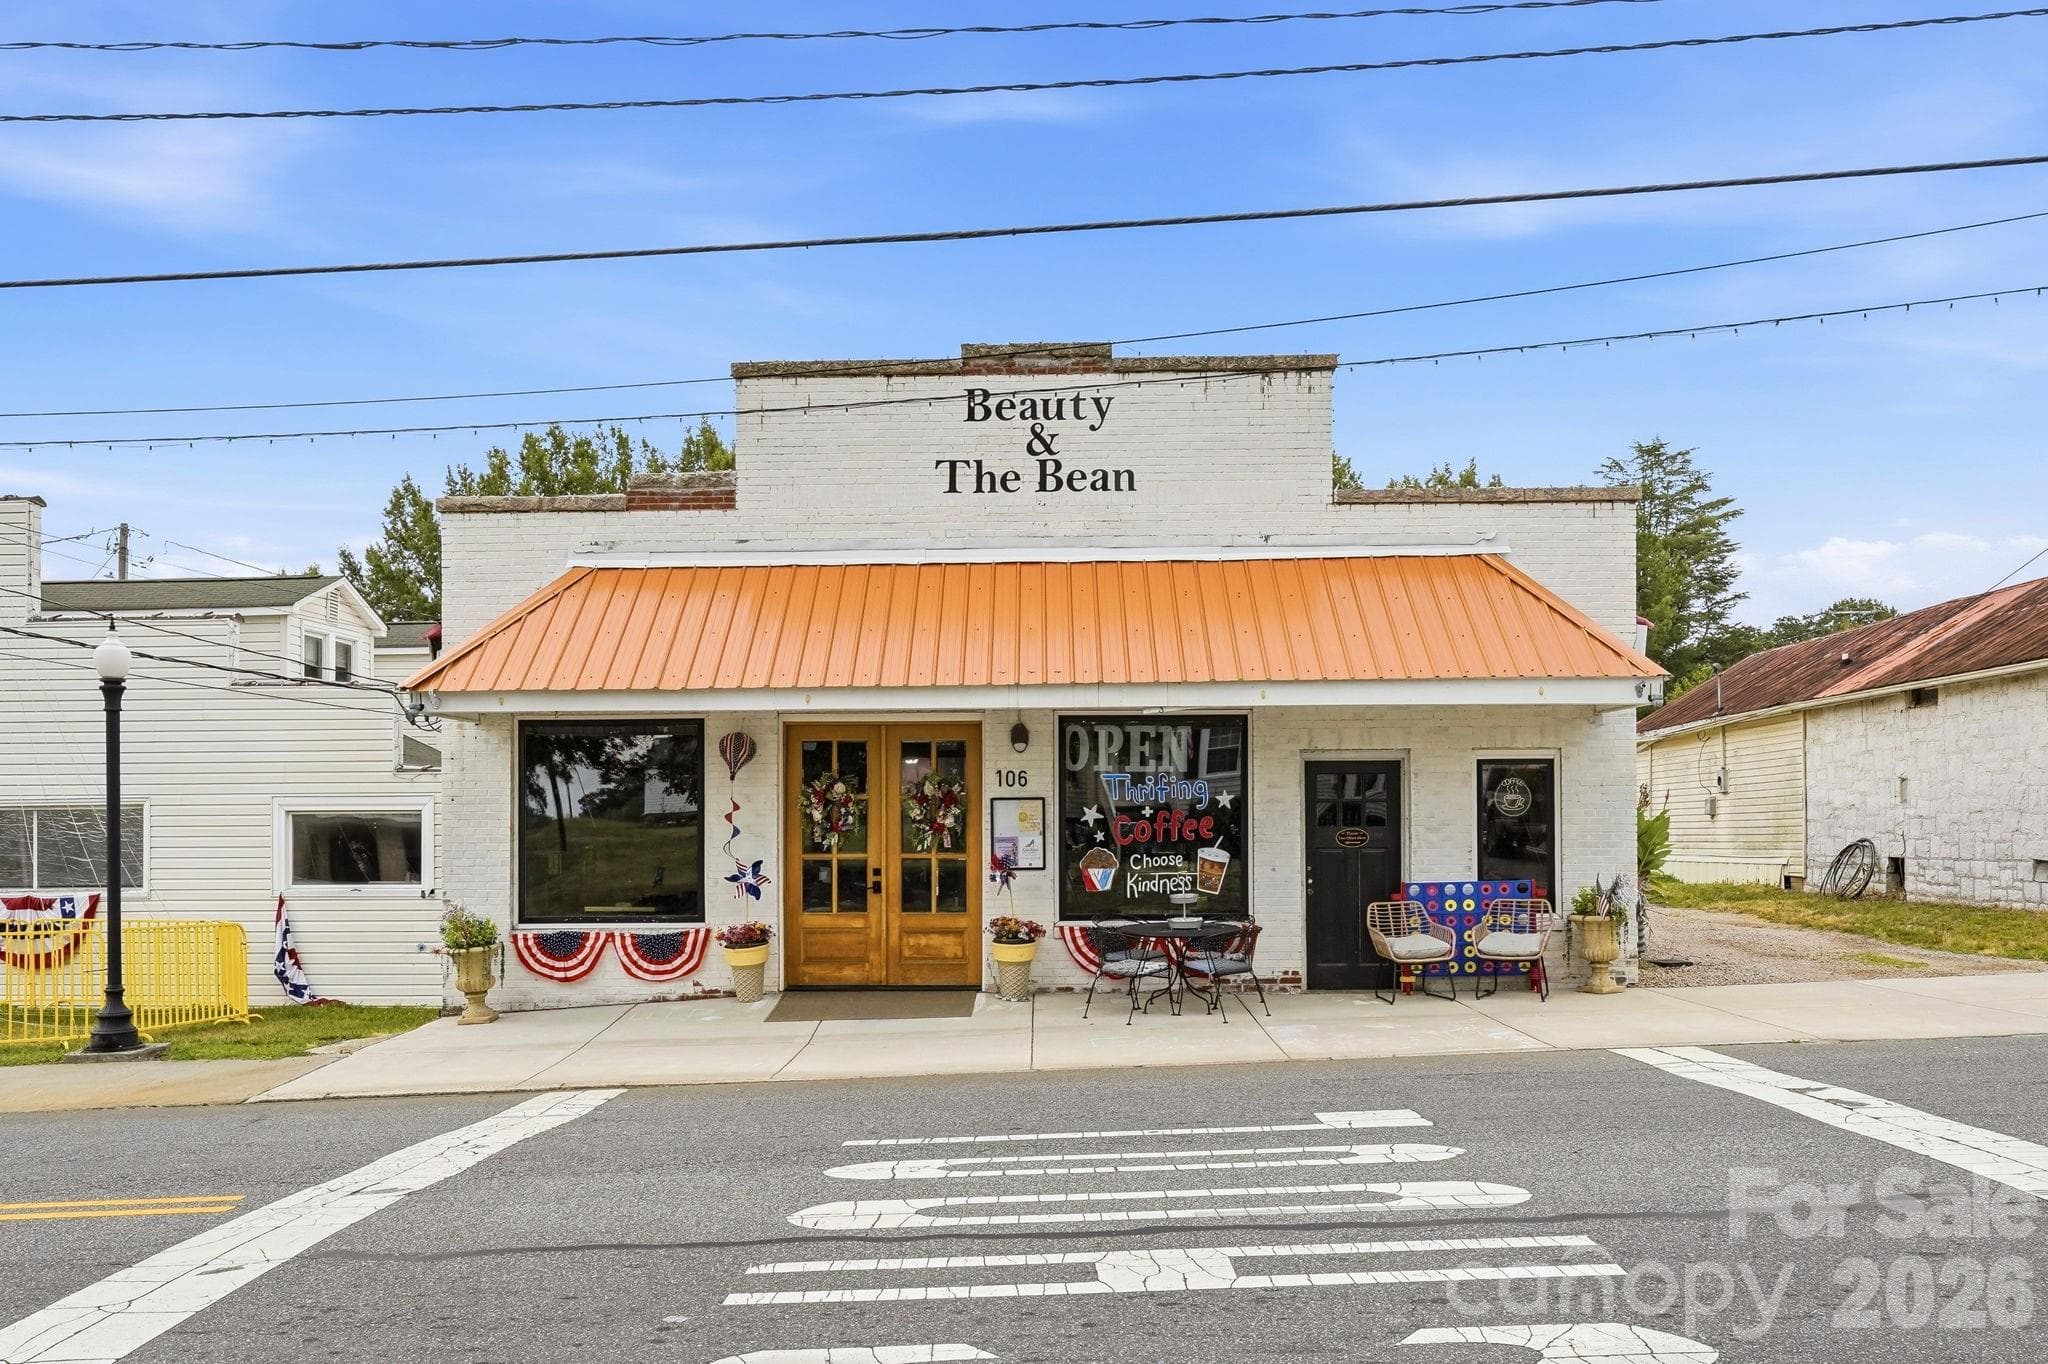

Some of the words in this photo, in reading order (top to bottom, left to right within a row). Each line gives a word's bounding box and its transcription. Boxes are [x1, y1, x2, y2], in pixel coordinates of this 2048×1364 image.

[963, 388, 1115, 432] Beauty
[1025, 422, 1061, 457] &
[935, 459, 1021, 494] The
[1034, 458, 1137, 493] Bean
[1065, 724, 1193, 773] OPEN
[995, 769, 1028, 787] 106
[1112, 808, 1215, 846] Coffee
[1130, 853, 1184, 870] Choose
[1126, 872, 1193, 899] Kindness
